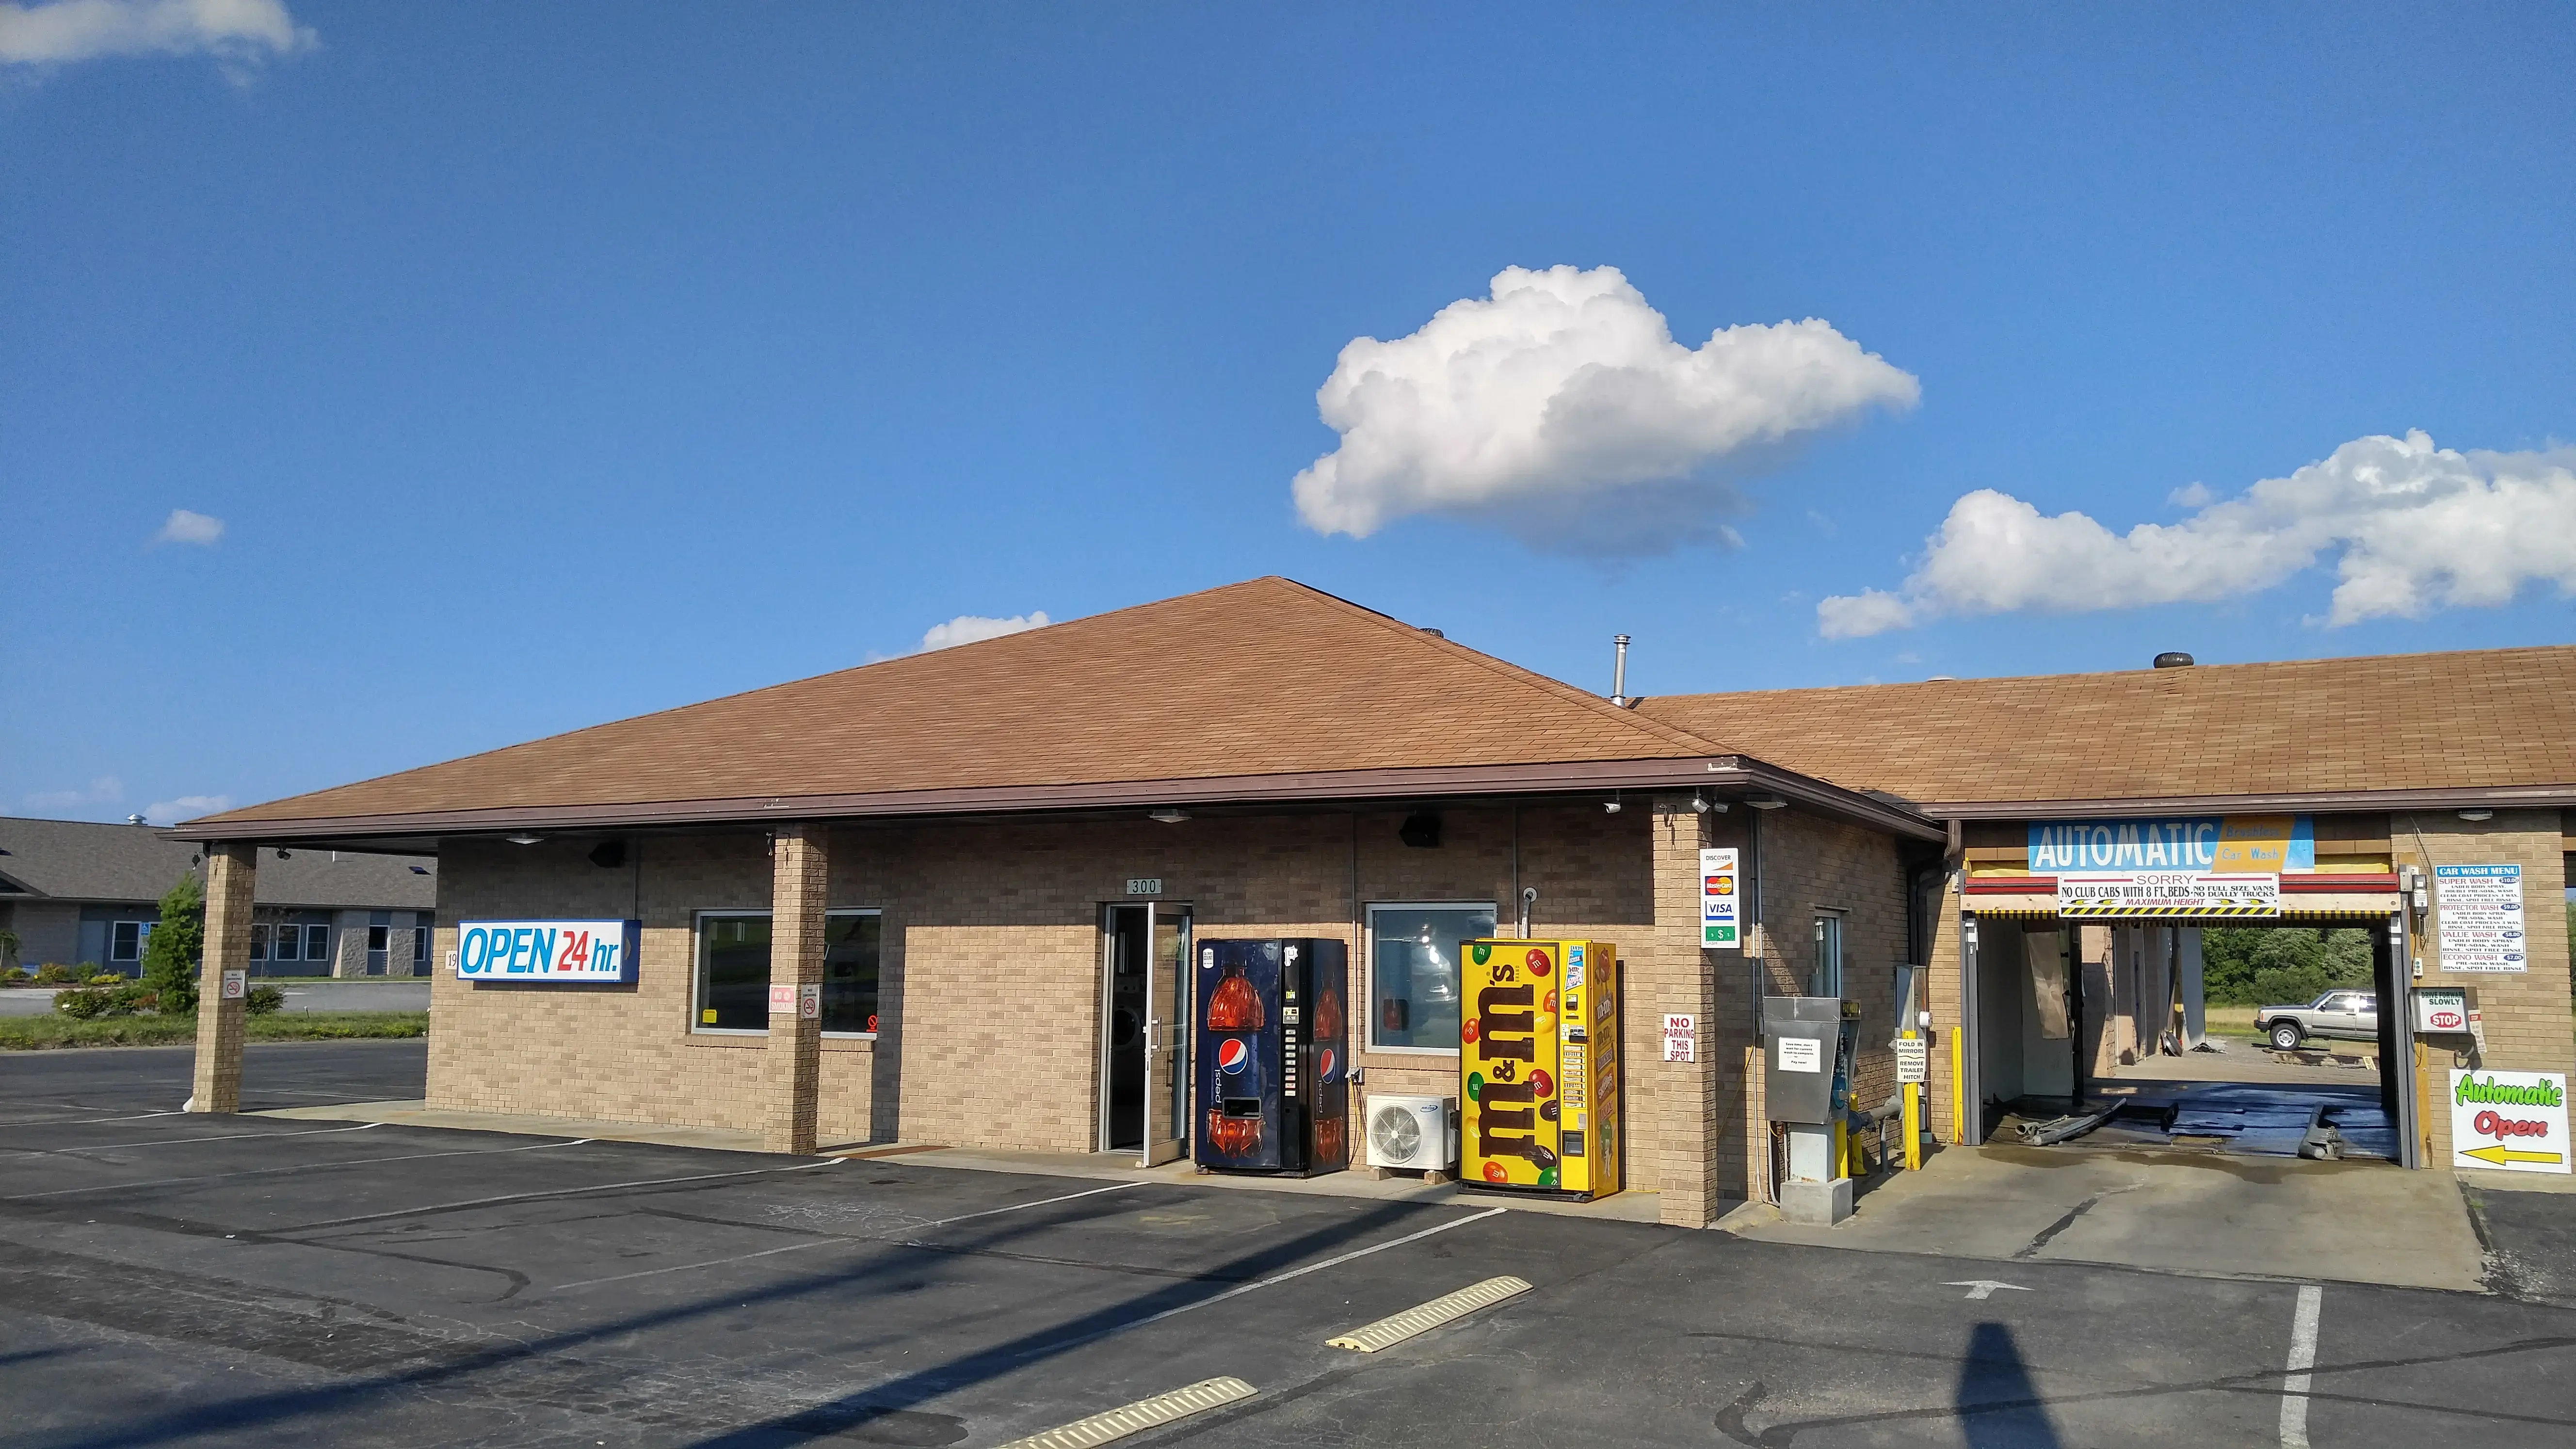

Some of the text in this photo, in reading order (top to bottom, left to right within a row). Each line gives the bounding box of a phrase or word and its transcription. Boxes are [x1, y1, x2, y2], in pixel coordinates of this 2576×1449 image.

[2226, 825, 2280, 837] Brushless
[2035, 823, 2213, 867] AUTOMATIC
[2222, 847, 2278, 860] Car Wash
[2137, 875, 2193, 885] SORRY
[1133, 880, 1156, 893] 300
[2062, 887, 2072, 897] NO
[2075, 887, 2095, 897] CLUB
[2098, 886, 2120, 897] CABS
[2123, 886, 2143, 897] WITH
[2146, 887, 2151, 897] 8
[2168, 886, 2190, 897] BEDS
[1708, 904, 1732, 913] VISA
[1718, 929, 1723, 939] $
[461, 928, 619, 973] OPEN 24 hr.
[448, 953, 456, 966] 19
[774, 991, 782, 1000] NO
[771, 1002, 794, 1010] SMOKING
[1671, 1018, 1689, 1028] NO
[2432, 1015, 2459, 1025] STOP
[1664, 1028, 1694, 1039] PARKING
[1672, 1040, 1689, 1050] THIS
[1671, 1051, 1690, 1061] SPOT
[2456, 1074, 2562, 1107] Automatic
[2474, 1111, 2548, 1141] Open
